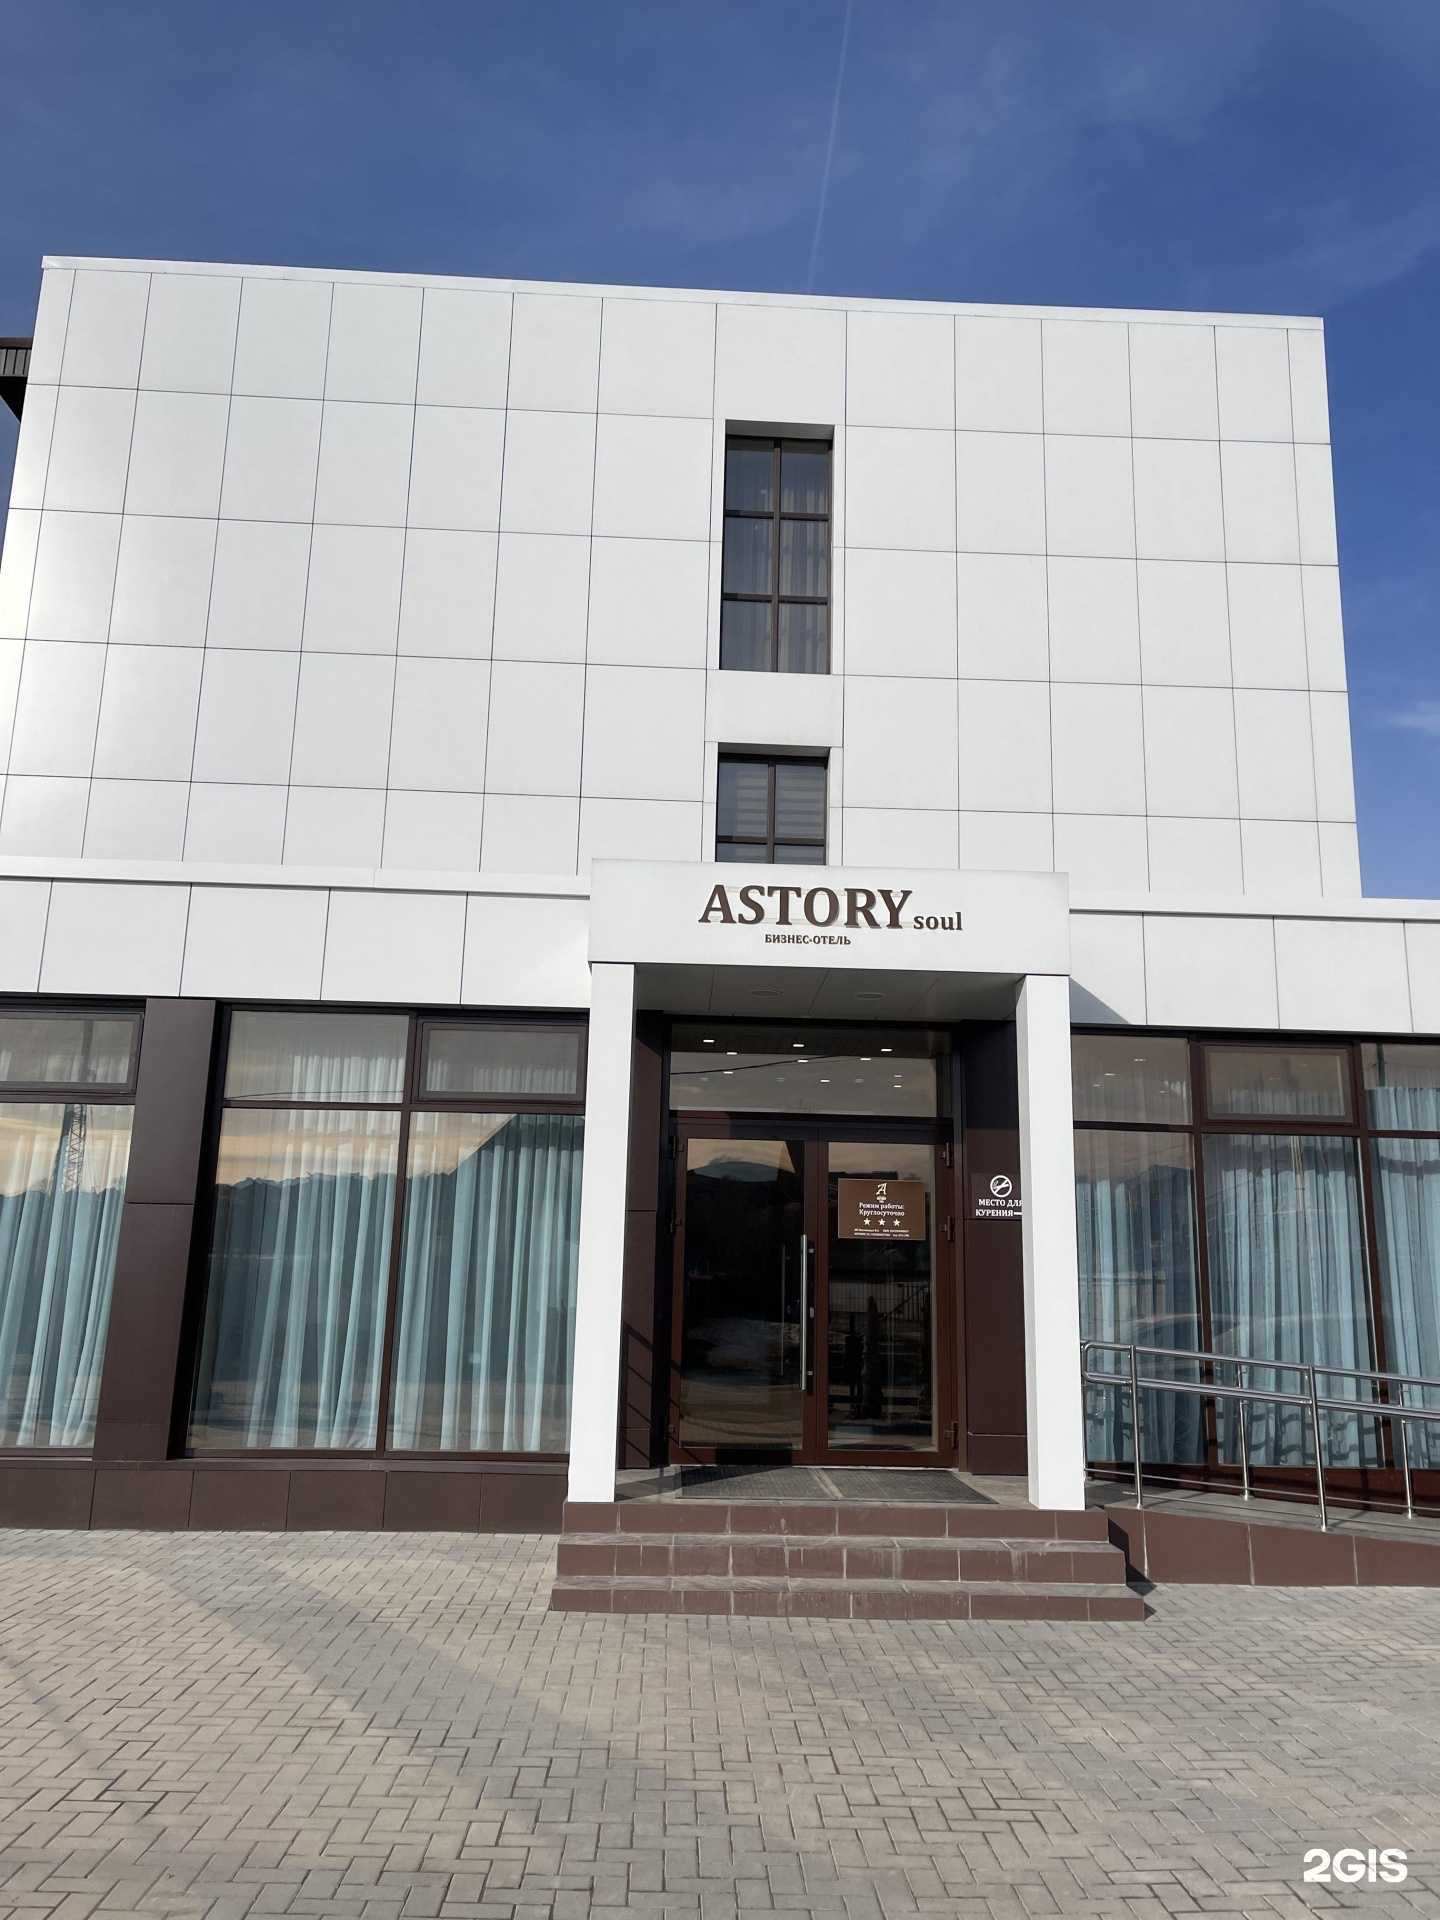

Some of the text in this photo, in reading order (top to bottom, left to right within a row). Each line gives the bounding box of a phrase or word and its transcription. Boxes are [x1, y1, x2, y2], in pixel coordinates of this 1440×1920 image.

[698, 884, 962, 931] ASTORY soul
[764, 933, 851, 945] БИЗНЕС-ОТЕЛЬ
[859, 1209, 905, 1217] Круглосуточно
